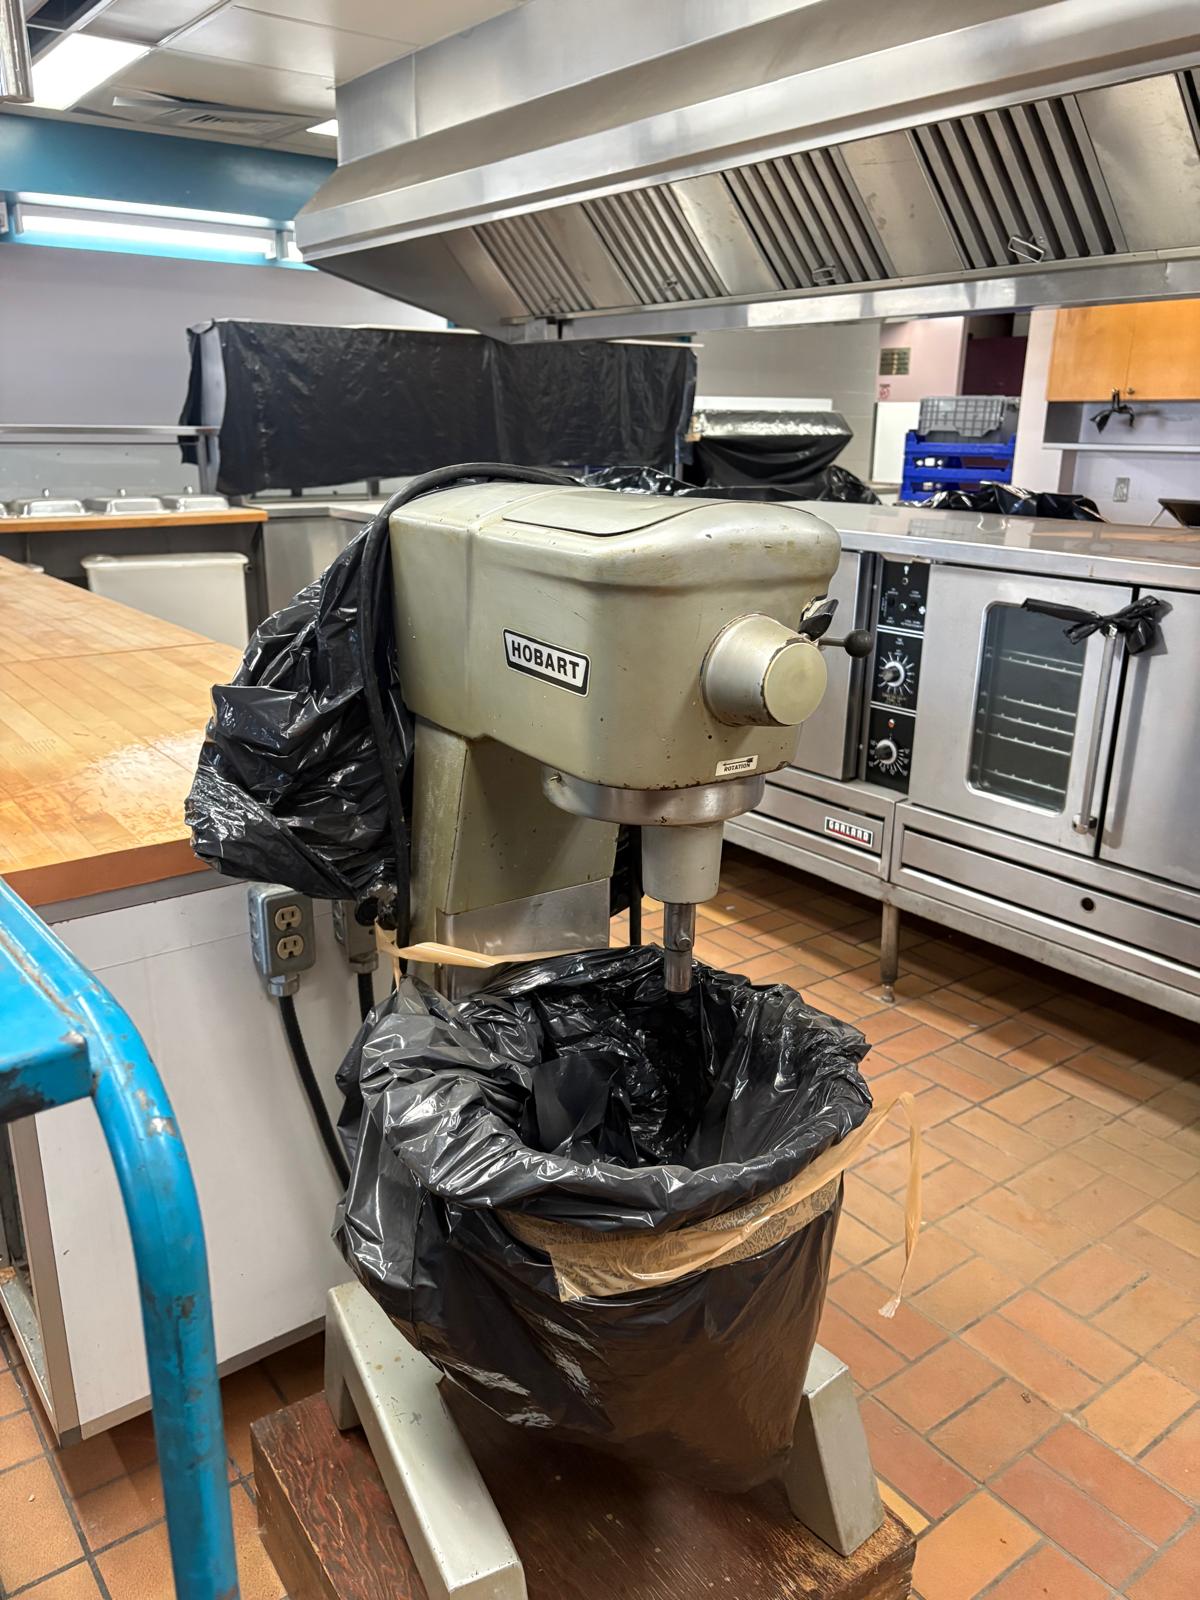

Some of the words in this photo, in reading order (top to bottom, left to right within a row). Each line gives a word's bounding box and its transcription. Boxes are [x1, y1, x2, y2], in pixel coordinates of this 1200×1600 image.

[511, 639, 580, 680] HOBART
[723, 762, 751, 772] ROTATION
[828, 820, 869, 842] GARLAND
